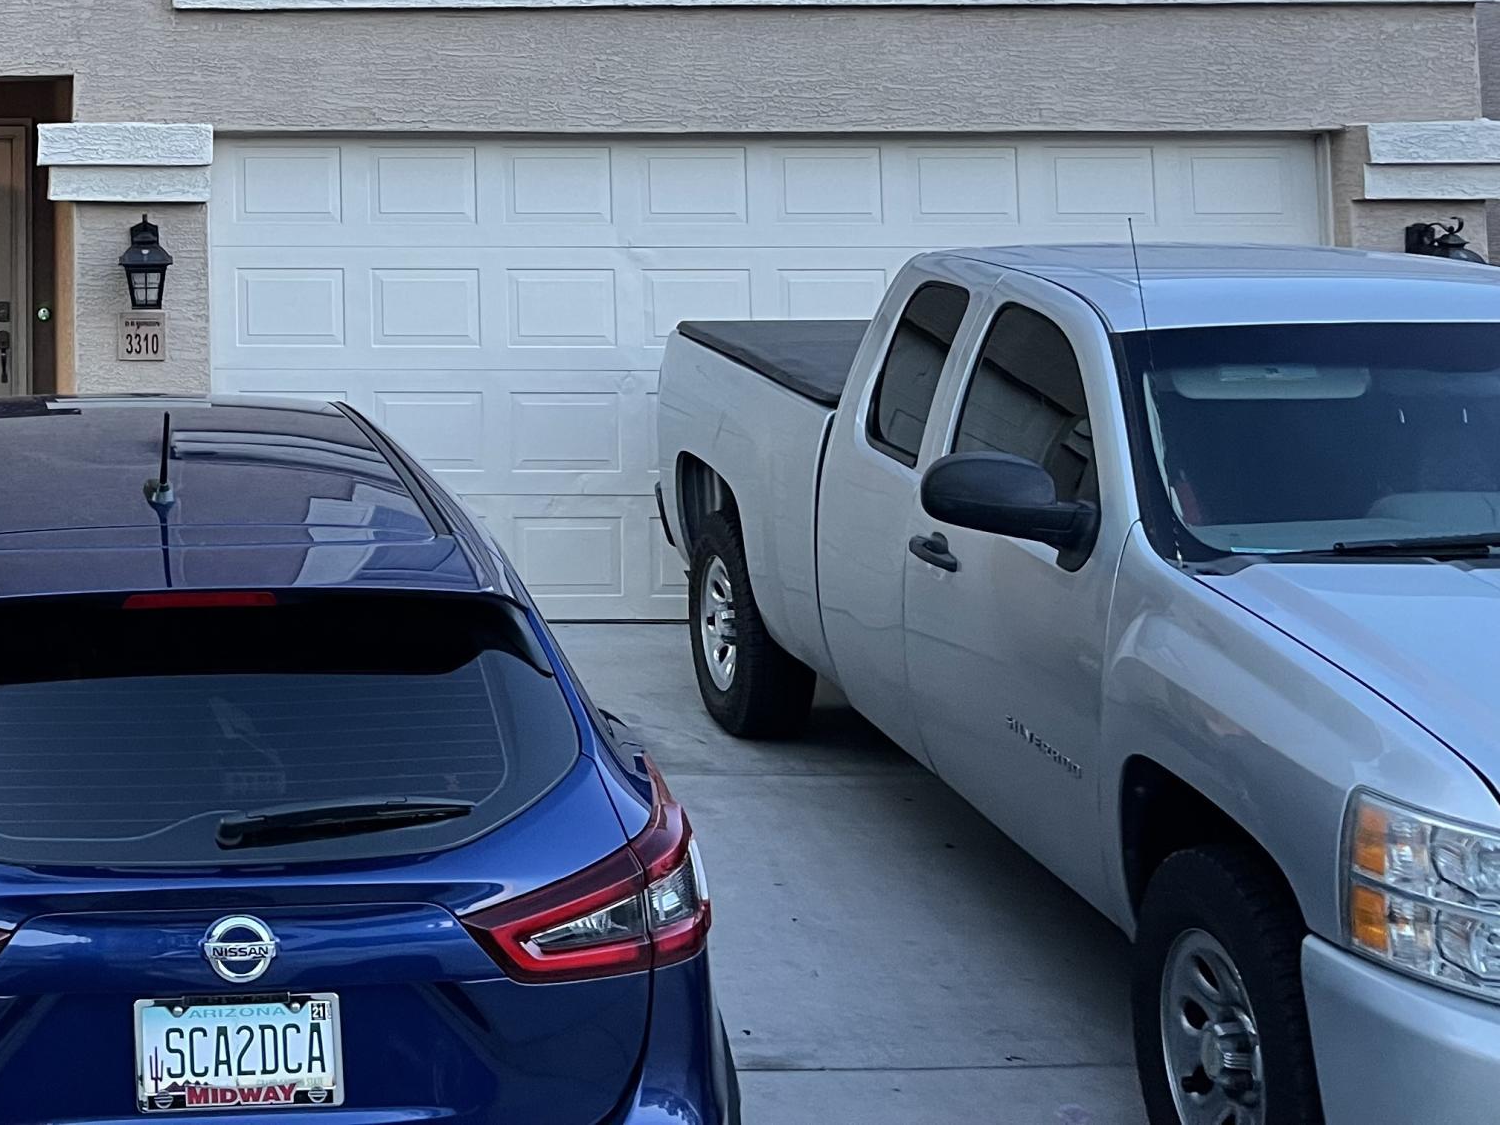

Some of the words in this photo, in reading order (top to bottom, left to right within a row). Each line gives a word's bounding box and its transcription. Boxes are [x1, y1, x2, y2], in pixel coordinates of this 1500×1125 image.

[126, 333, 159, 354] 3310
[212, 946, 269, 957] NISSAN
[188, 1006, 286, 1019] ARIZONA
[312, 1006, 324, 1018] 21
[165, 1022, 326, 1079] SCA2DCA
[187, 1082, 297, 1105] MIDWAY
